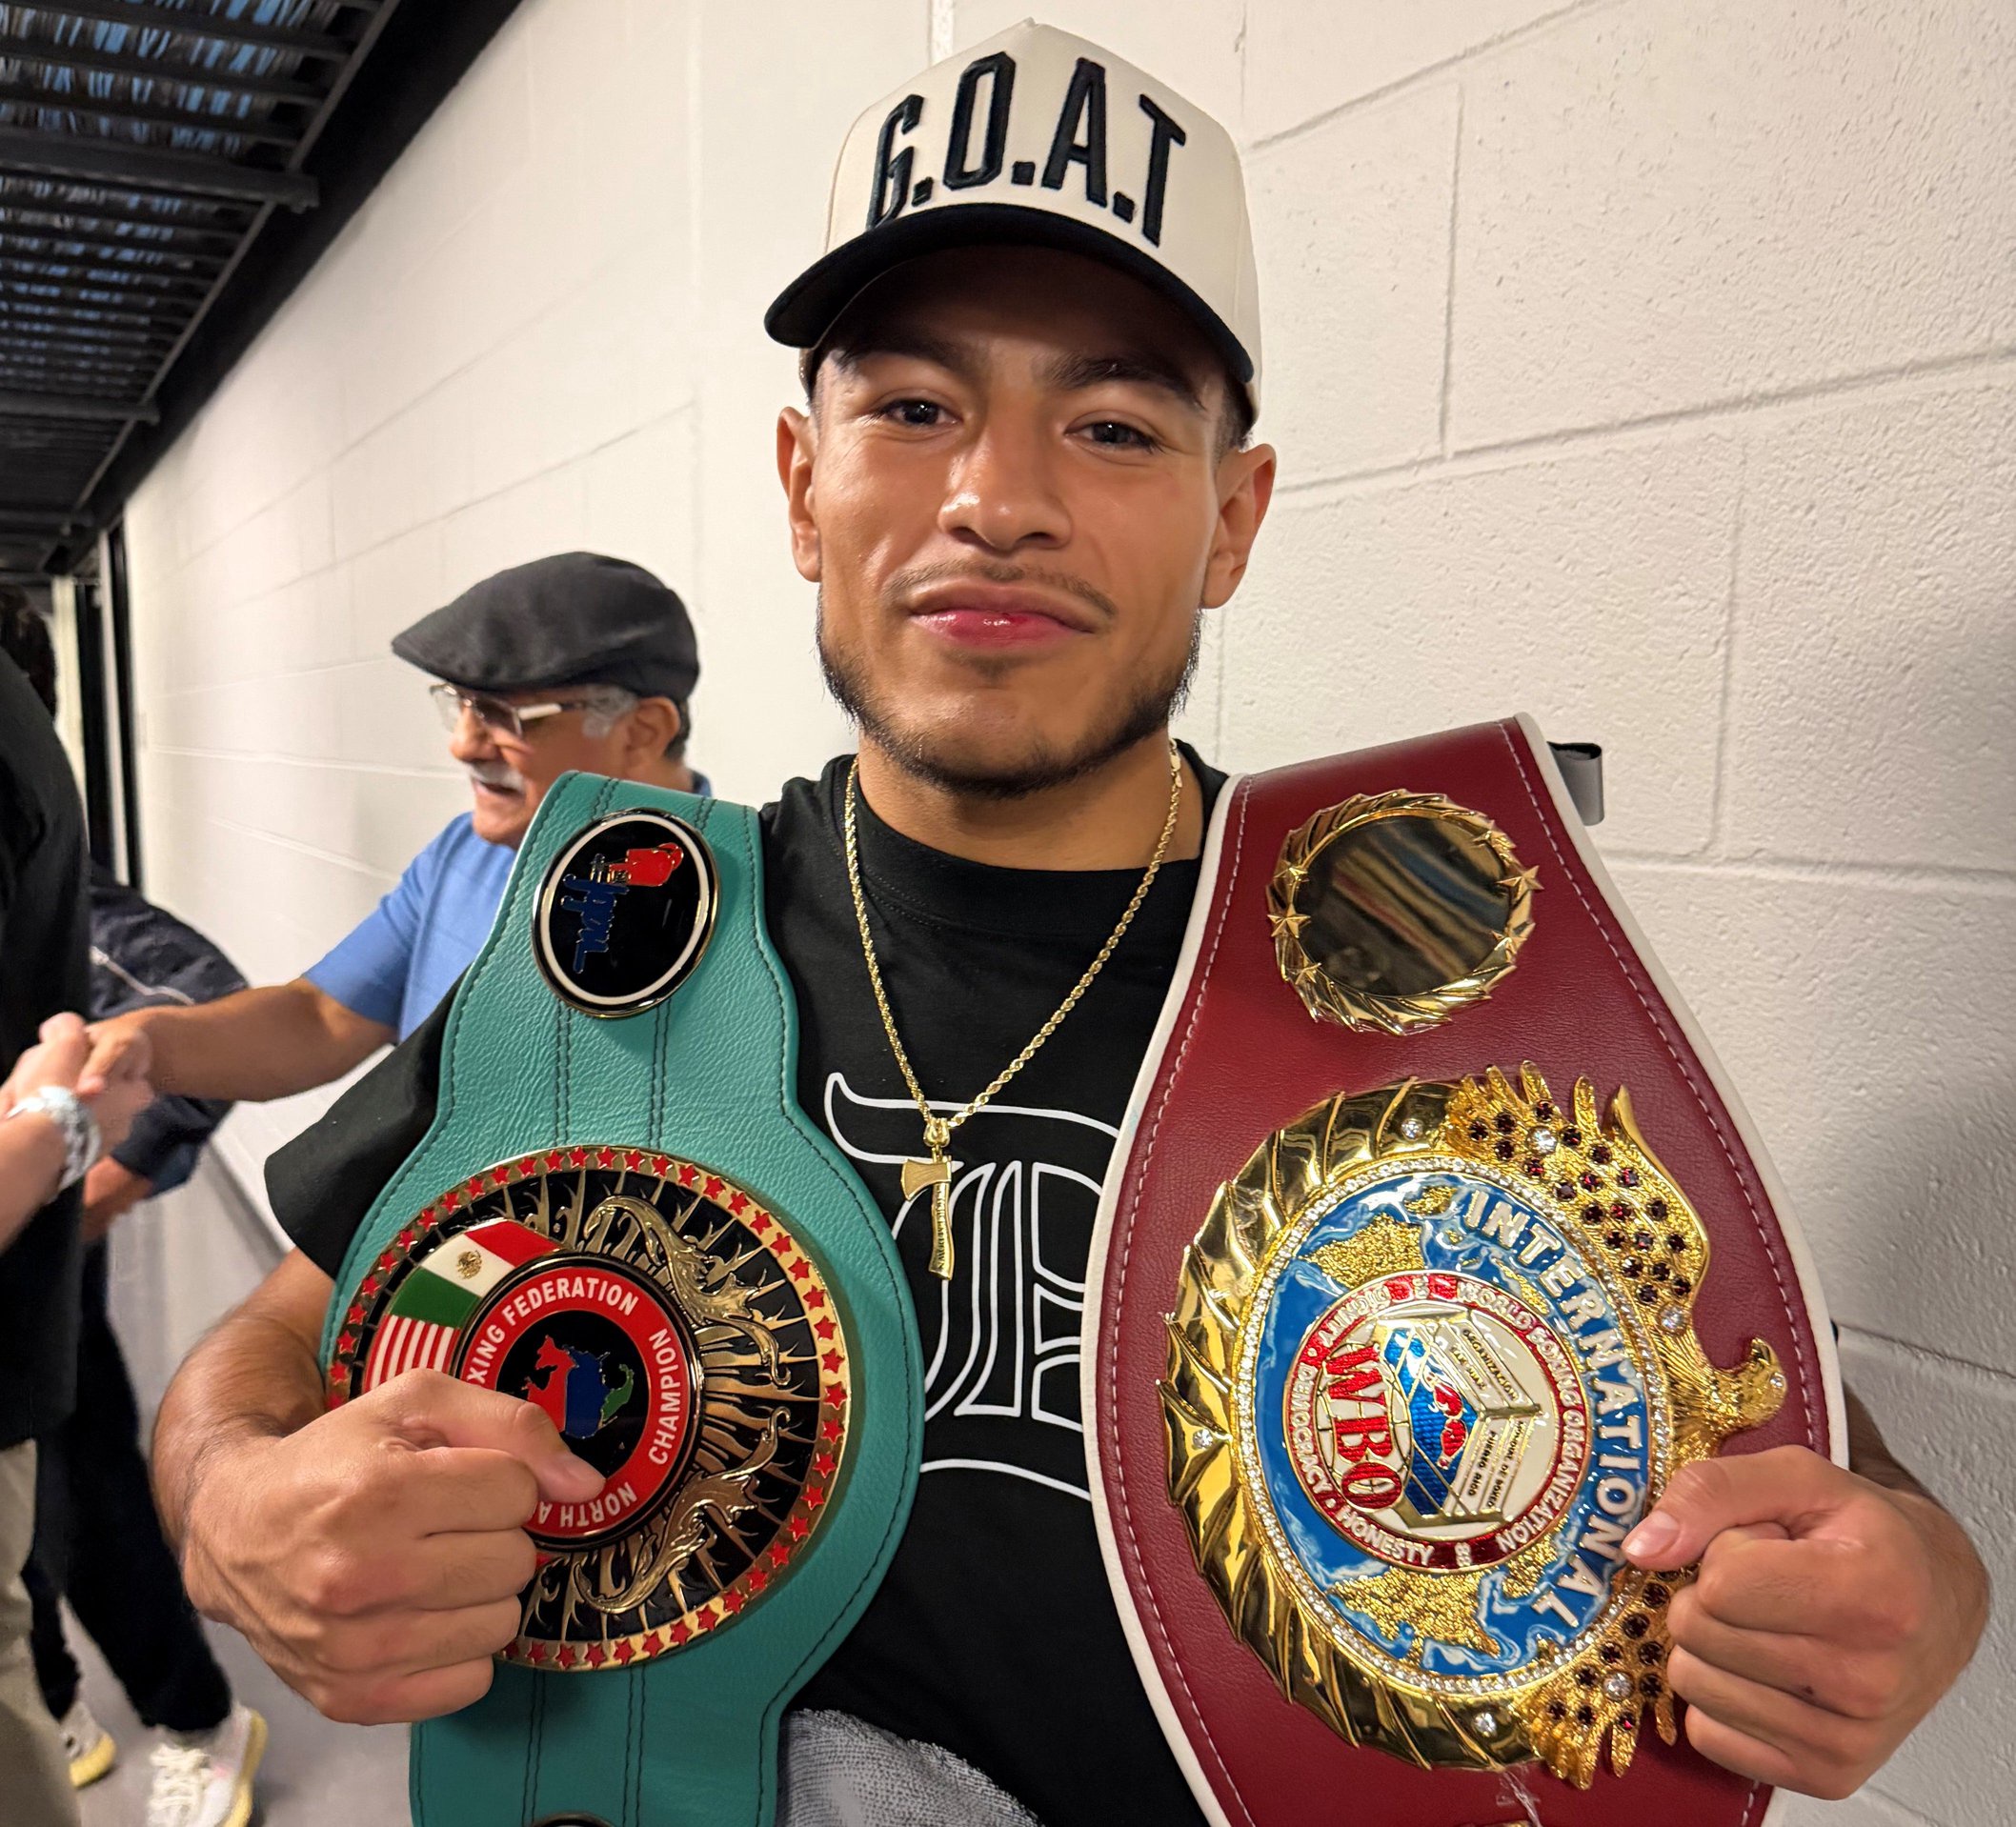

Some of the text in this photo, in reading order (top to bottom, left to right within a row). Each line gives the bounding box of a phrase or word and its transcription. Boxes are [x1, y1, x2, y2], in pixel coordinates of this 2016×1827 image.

[866, 50, 1186, 248] G.O.A.T
[466, 1276, 639, 1384] XING FEDERATION
[1318, 1285, 1392, 1348] DIGNITY
[648, 1328, 681, 1465] CHAMPION
[1290, 1363, 1333, 1496] DEMOCRACY
[1322, 1344, 1402, 1512] WBO
[1456, 1280, 1587, 1553] WORLD BOXING ORGANIZATION
[1465, 1188, 1643, 1627] INTERNATIONAL
[559, 1482, 638, 1528] NORTH
[1334, 1507, 1435, 1567] HONESTY
